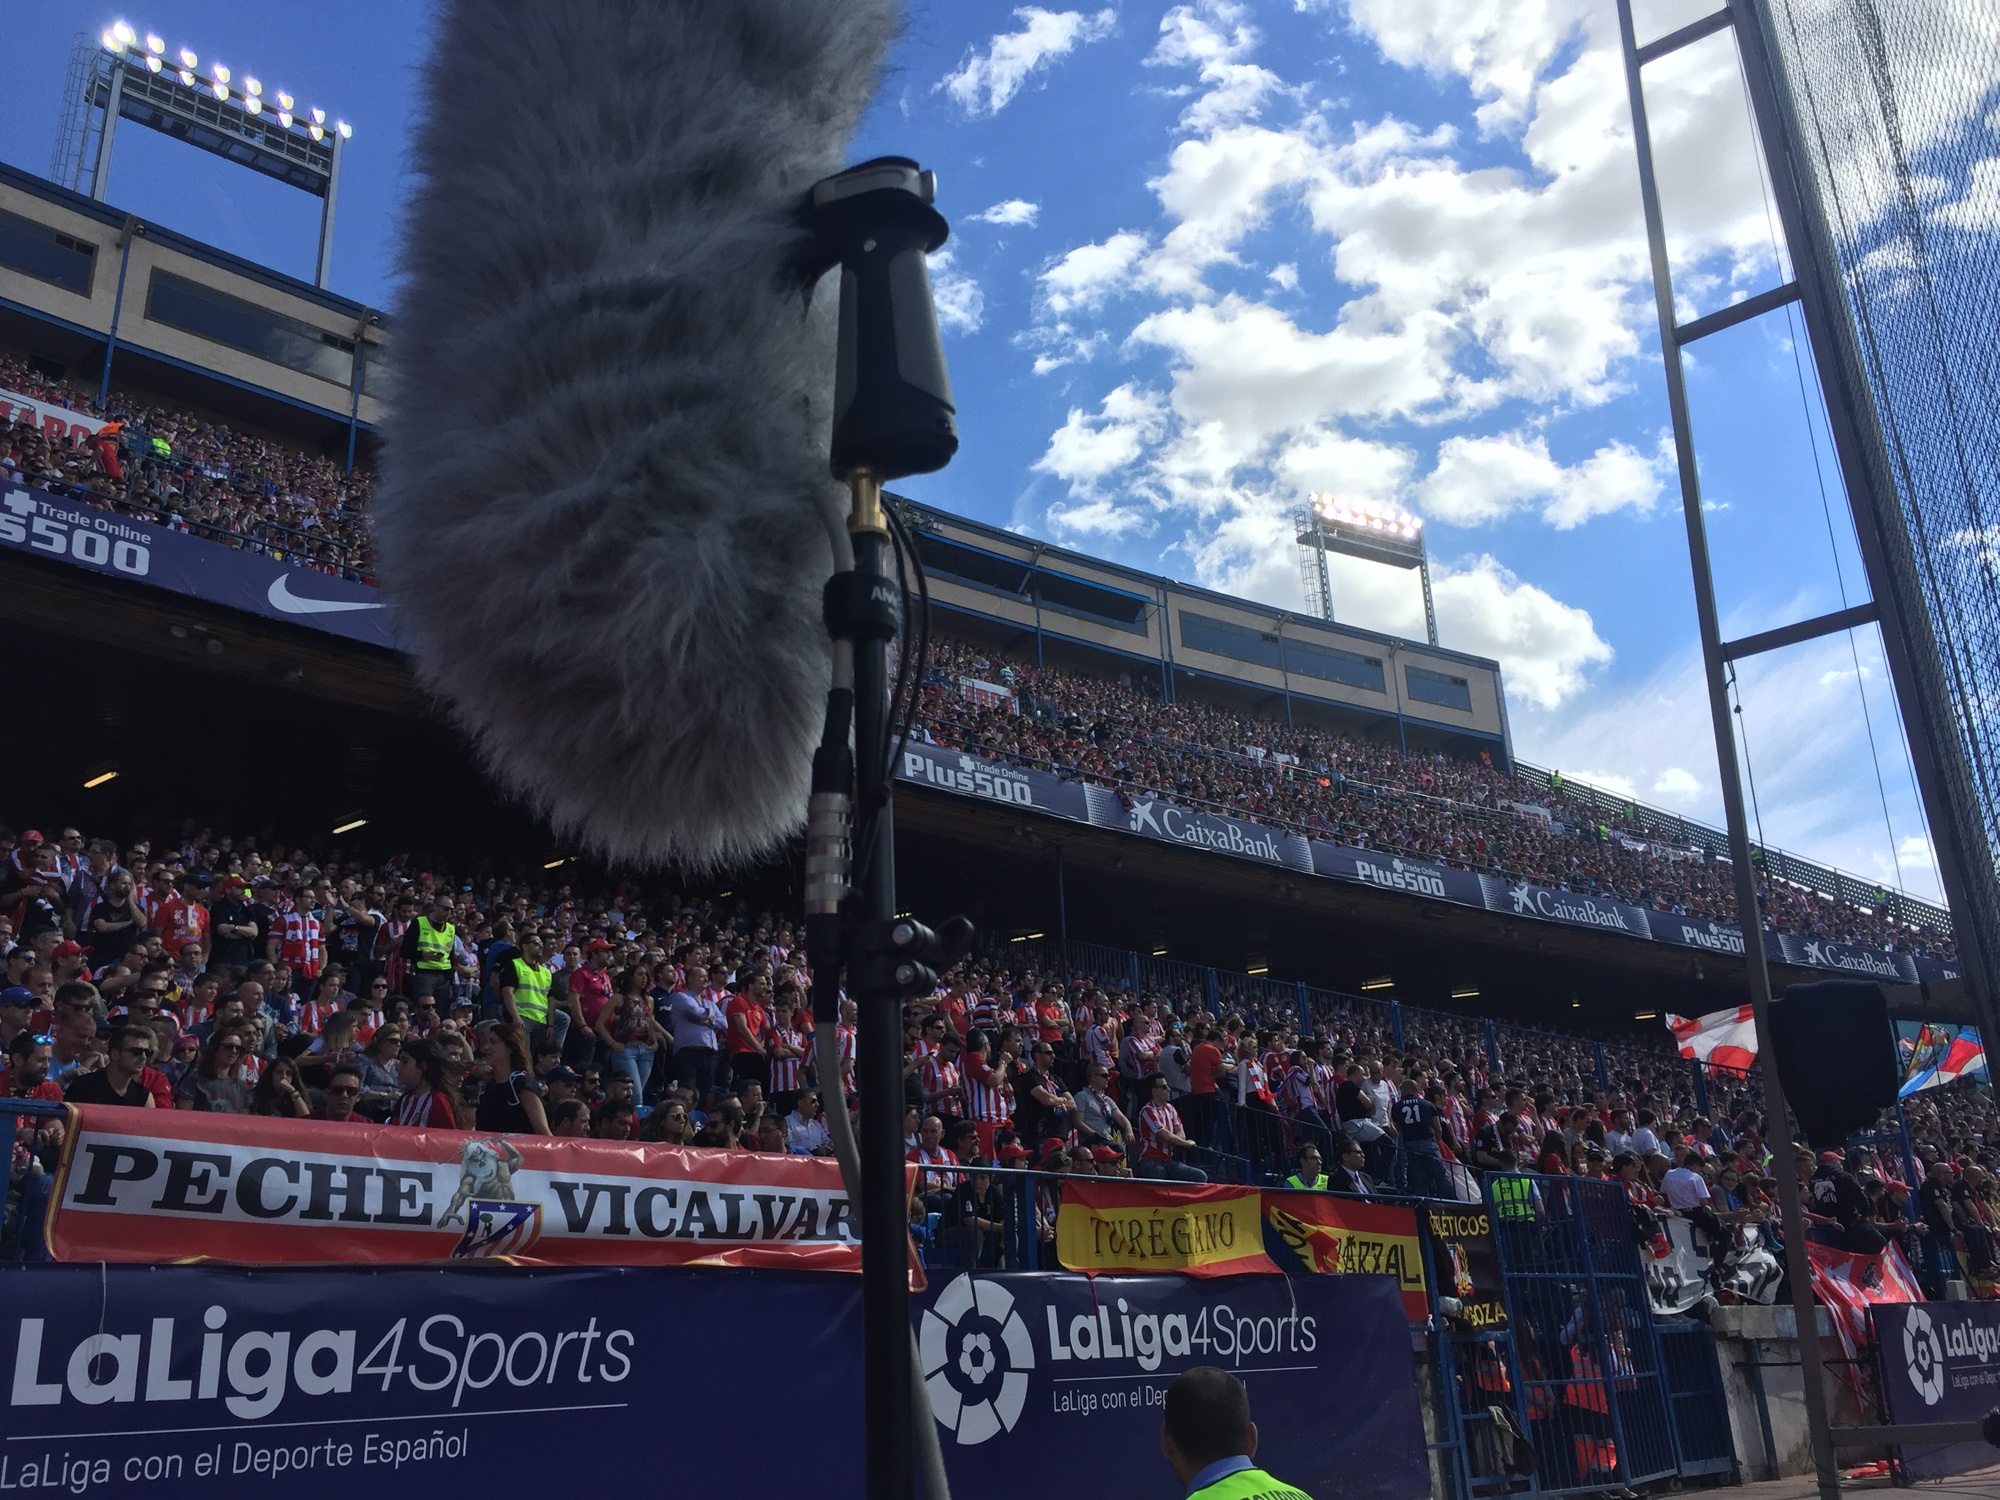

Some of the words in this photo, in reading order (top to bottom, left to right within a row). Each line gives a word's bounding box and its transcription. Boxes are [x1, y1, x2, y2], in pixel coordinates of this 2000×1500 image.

[39, 502, 90, 528] Trade
[95, 518, 151, 545] Online
[904, 752, 1032, 806] Plus500
[975, 761, 1000, 776] Trade
[1001, 767, 1029, 783] Online
[1163, 808, 1283, 862] CaixaBank
[1355, 860, 1445, 897] Plus500
[1536, 891, 1629, 930] CaixaBank
[1825, 945, 1900, 977] CaixaBank
[1401, 1104, 1421, 1124] 21
[73, 1143, 433, 1226] PECHE
[1089, 1208, 1236, 1262] TURÉGANO
[1046, 1298, 1317, 1371] LaLiga4Sports
[1942, 1318, 2000, 1363] LaLiga
[11, 1305, 634, 1420] LaLiga4Sports
[1053, 1389, 1097, 1416] LaLiga
[1101, 1391, 1127, 1409] con
[1130, 1386, 1142, 1407] el
[0, 1452, 111, 1494] LaLiga
[123, 1454, 183, 1482] con
[194, 1444, 222, 1477] el
[232, 1437, 353, 1479] Deporte
[363, 1428, 468, 1470] Español
